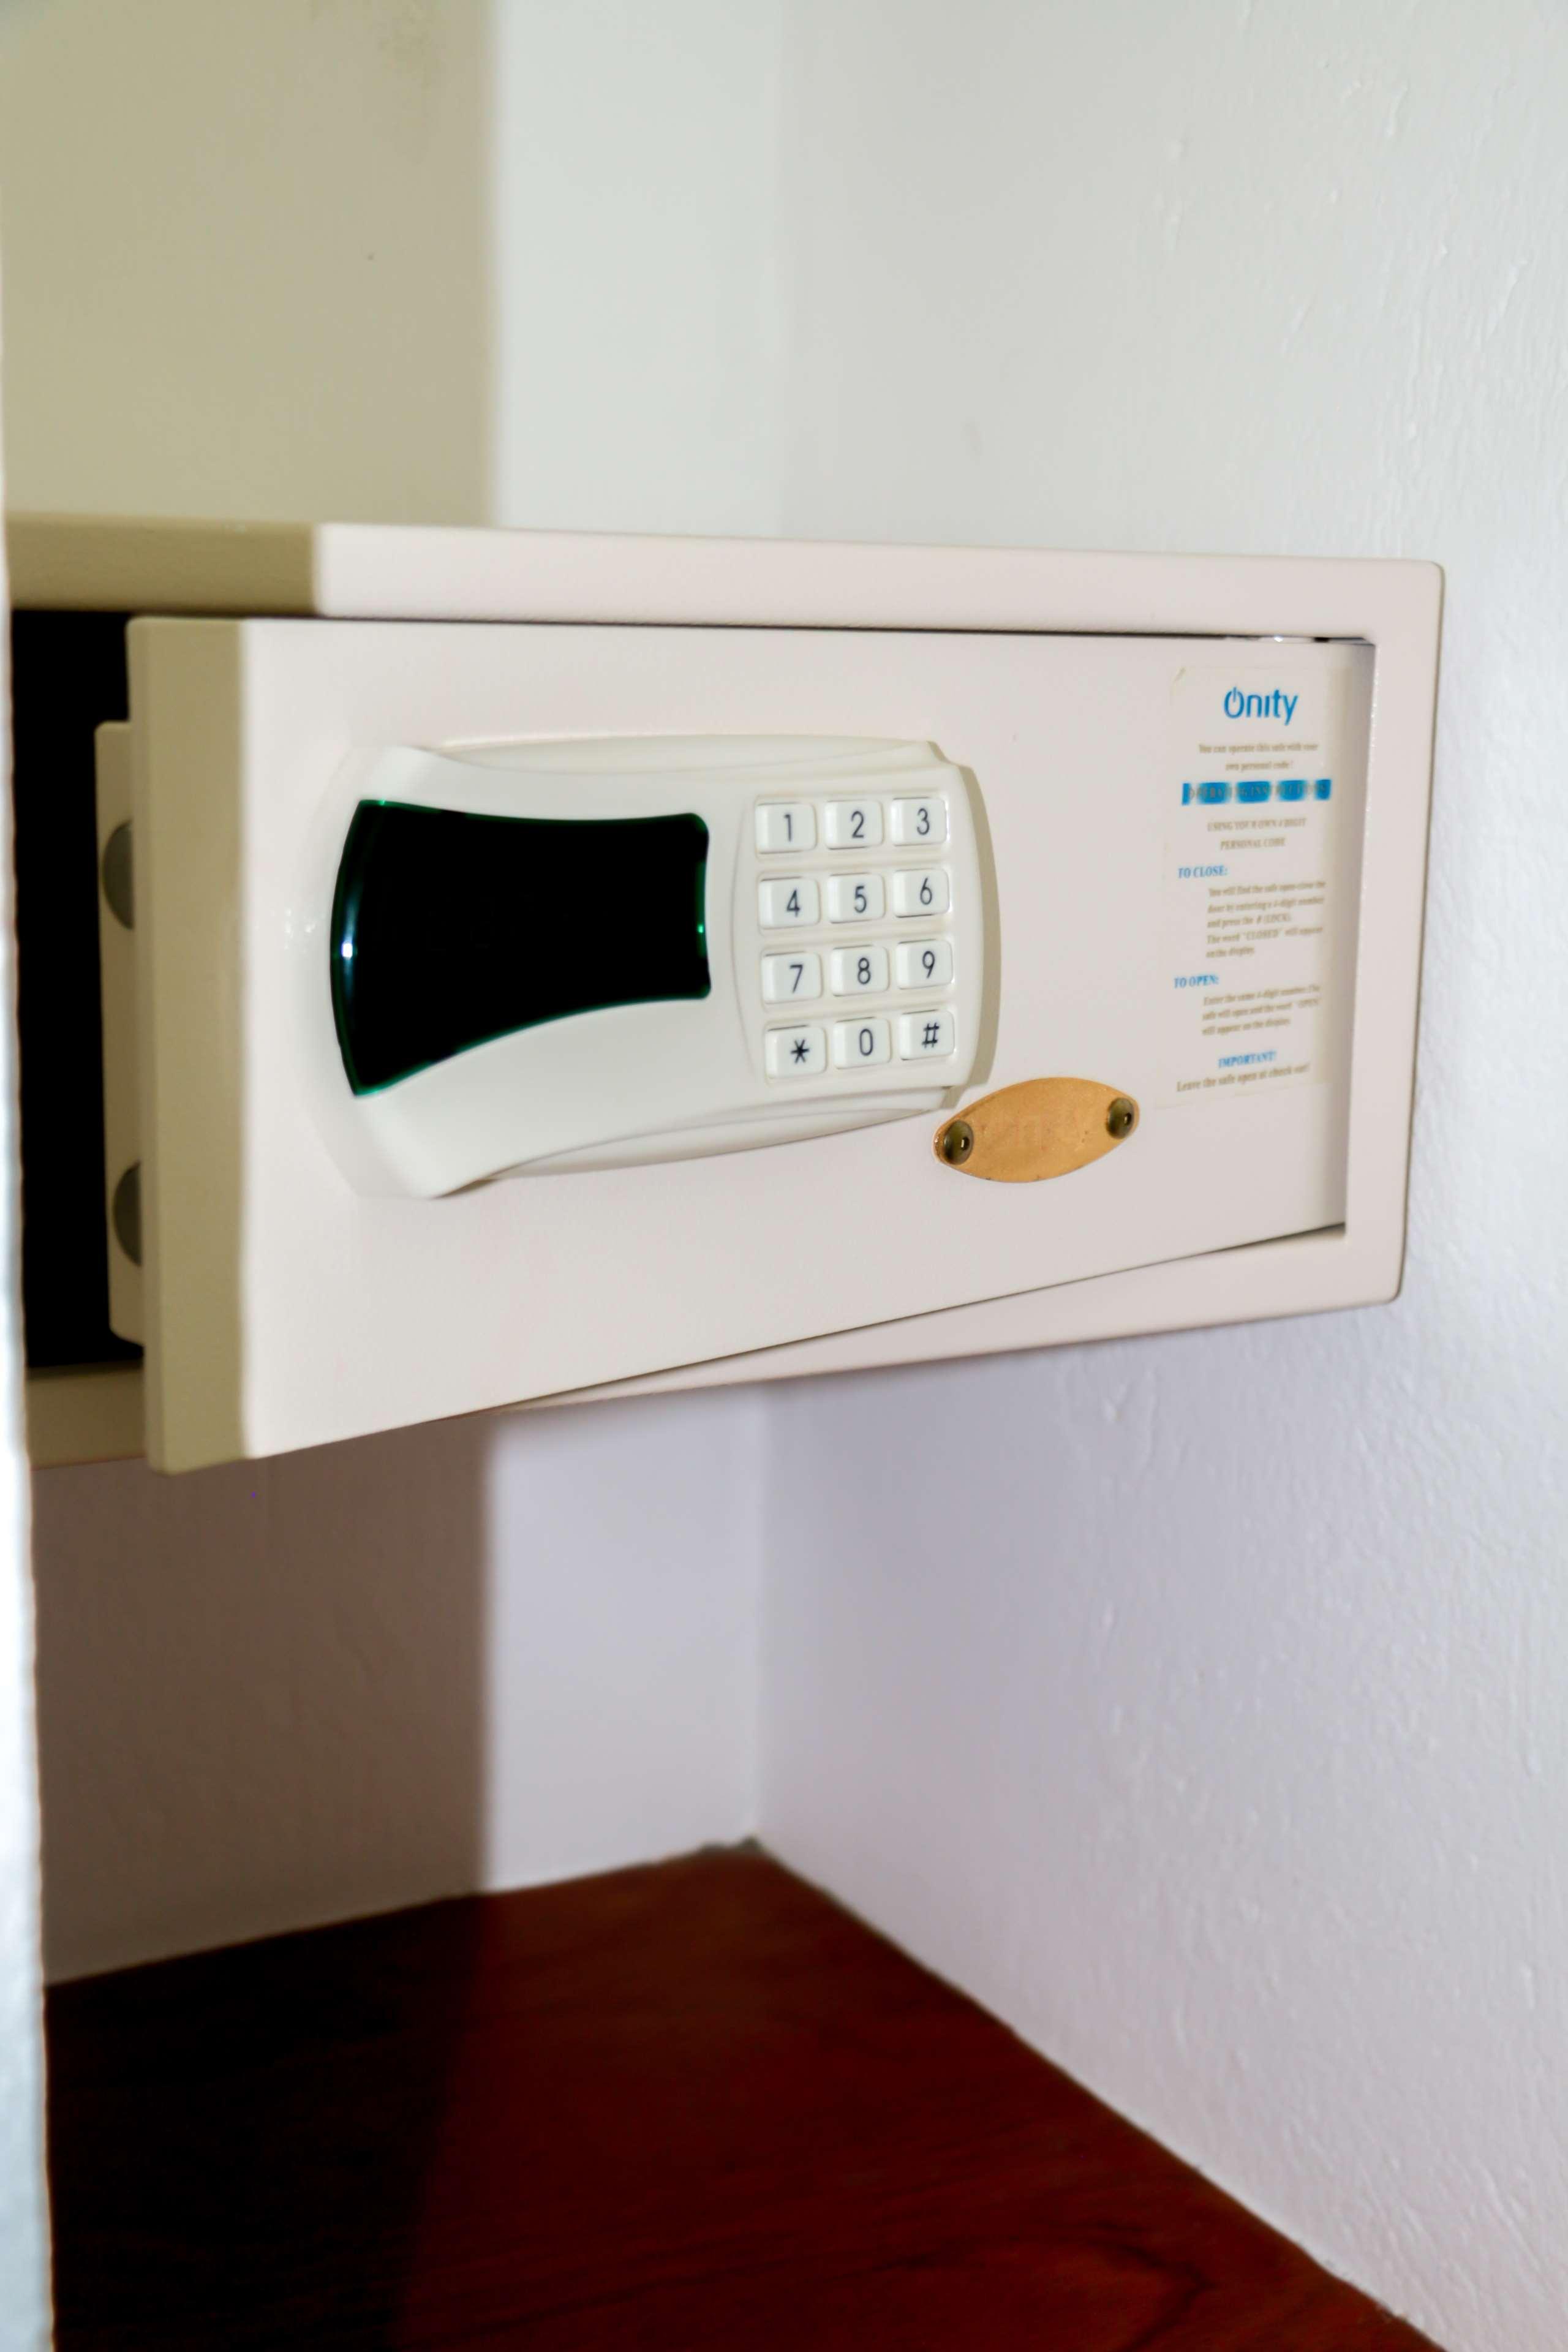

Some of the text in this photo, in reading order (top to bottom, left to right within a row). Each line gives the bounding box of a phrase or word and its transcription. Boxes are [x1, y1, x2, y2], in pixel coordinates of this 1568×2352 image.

[1223, 687, 1298, 726] Onity
[783, 807, 930, 842] 1 2 3
[1178, 867, 1191, 878] TO
[786, 876, 933, 917] 4 5 6
[789, 951, 935, 993] 7 8 9
[1174, 977, 1186, 989] TO
[858, 1028, 873, 1056] 0
[922, 1022, 939, 1048] #
